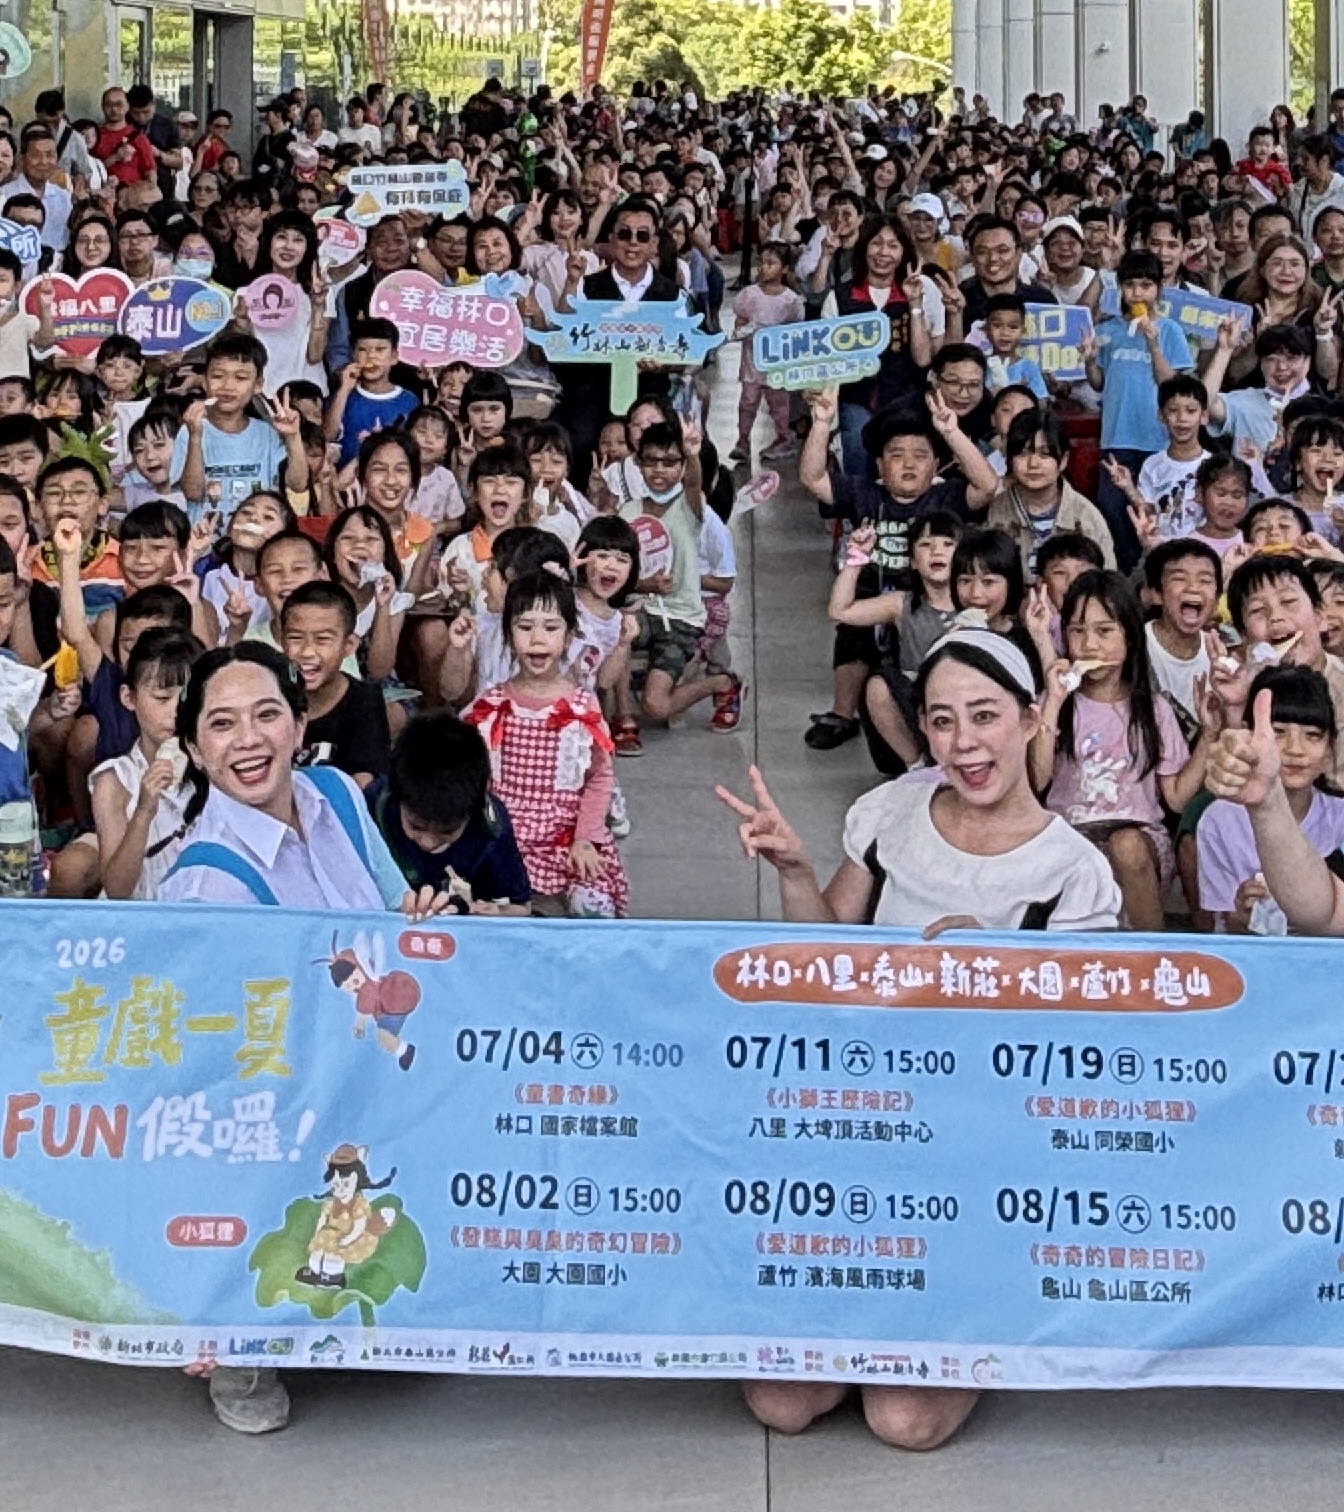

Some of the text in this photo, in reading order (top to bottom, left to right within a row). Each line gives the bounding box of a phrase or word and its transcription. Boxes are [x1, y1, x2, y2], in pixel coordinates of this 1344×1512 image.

[51, 296, 116, 316] 福八里
[127, 304, 181, 339] 泰山
[400, 286, 509, 325] 幸福林口
[398, 320, 505, 361] 宜居樂活
[56, 937, 126, 968] 2026
[38, 974, 292, 1085] 童戲一夏
[456, 1027, 565, 1071] 07/04
[613, 1042, 684, 1067] 14:00
[726, 1033, 831, 1077] 07/11
[884, 1050, 956, 1074] 15:00
[993, 1041, 1103, 1086] 07/19
[1153, 1057, 1227, 1083] 15:00
[2, 1092, 129, 1159] FUN
[495, 1113, 533, 1135] 林口
[749, 1117, 786, 1139] 八里
[1051, 1128, 1089, 1150] 泰山
[451, 1171, 559, 1216] 08/02
[609, 1187, 681, 1213] 15:00
[725, 1177, 835, 1223] 08/09
[886, 1195, 958, 1221] 15:00
[997, 1187, 1109, 1232] 08/15
[1161, 1204, 1236, 1231] 15:00
[758, 1264, 797, 1286] 蘆竹
